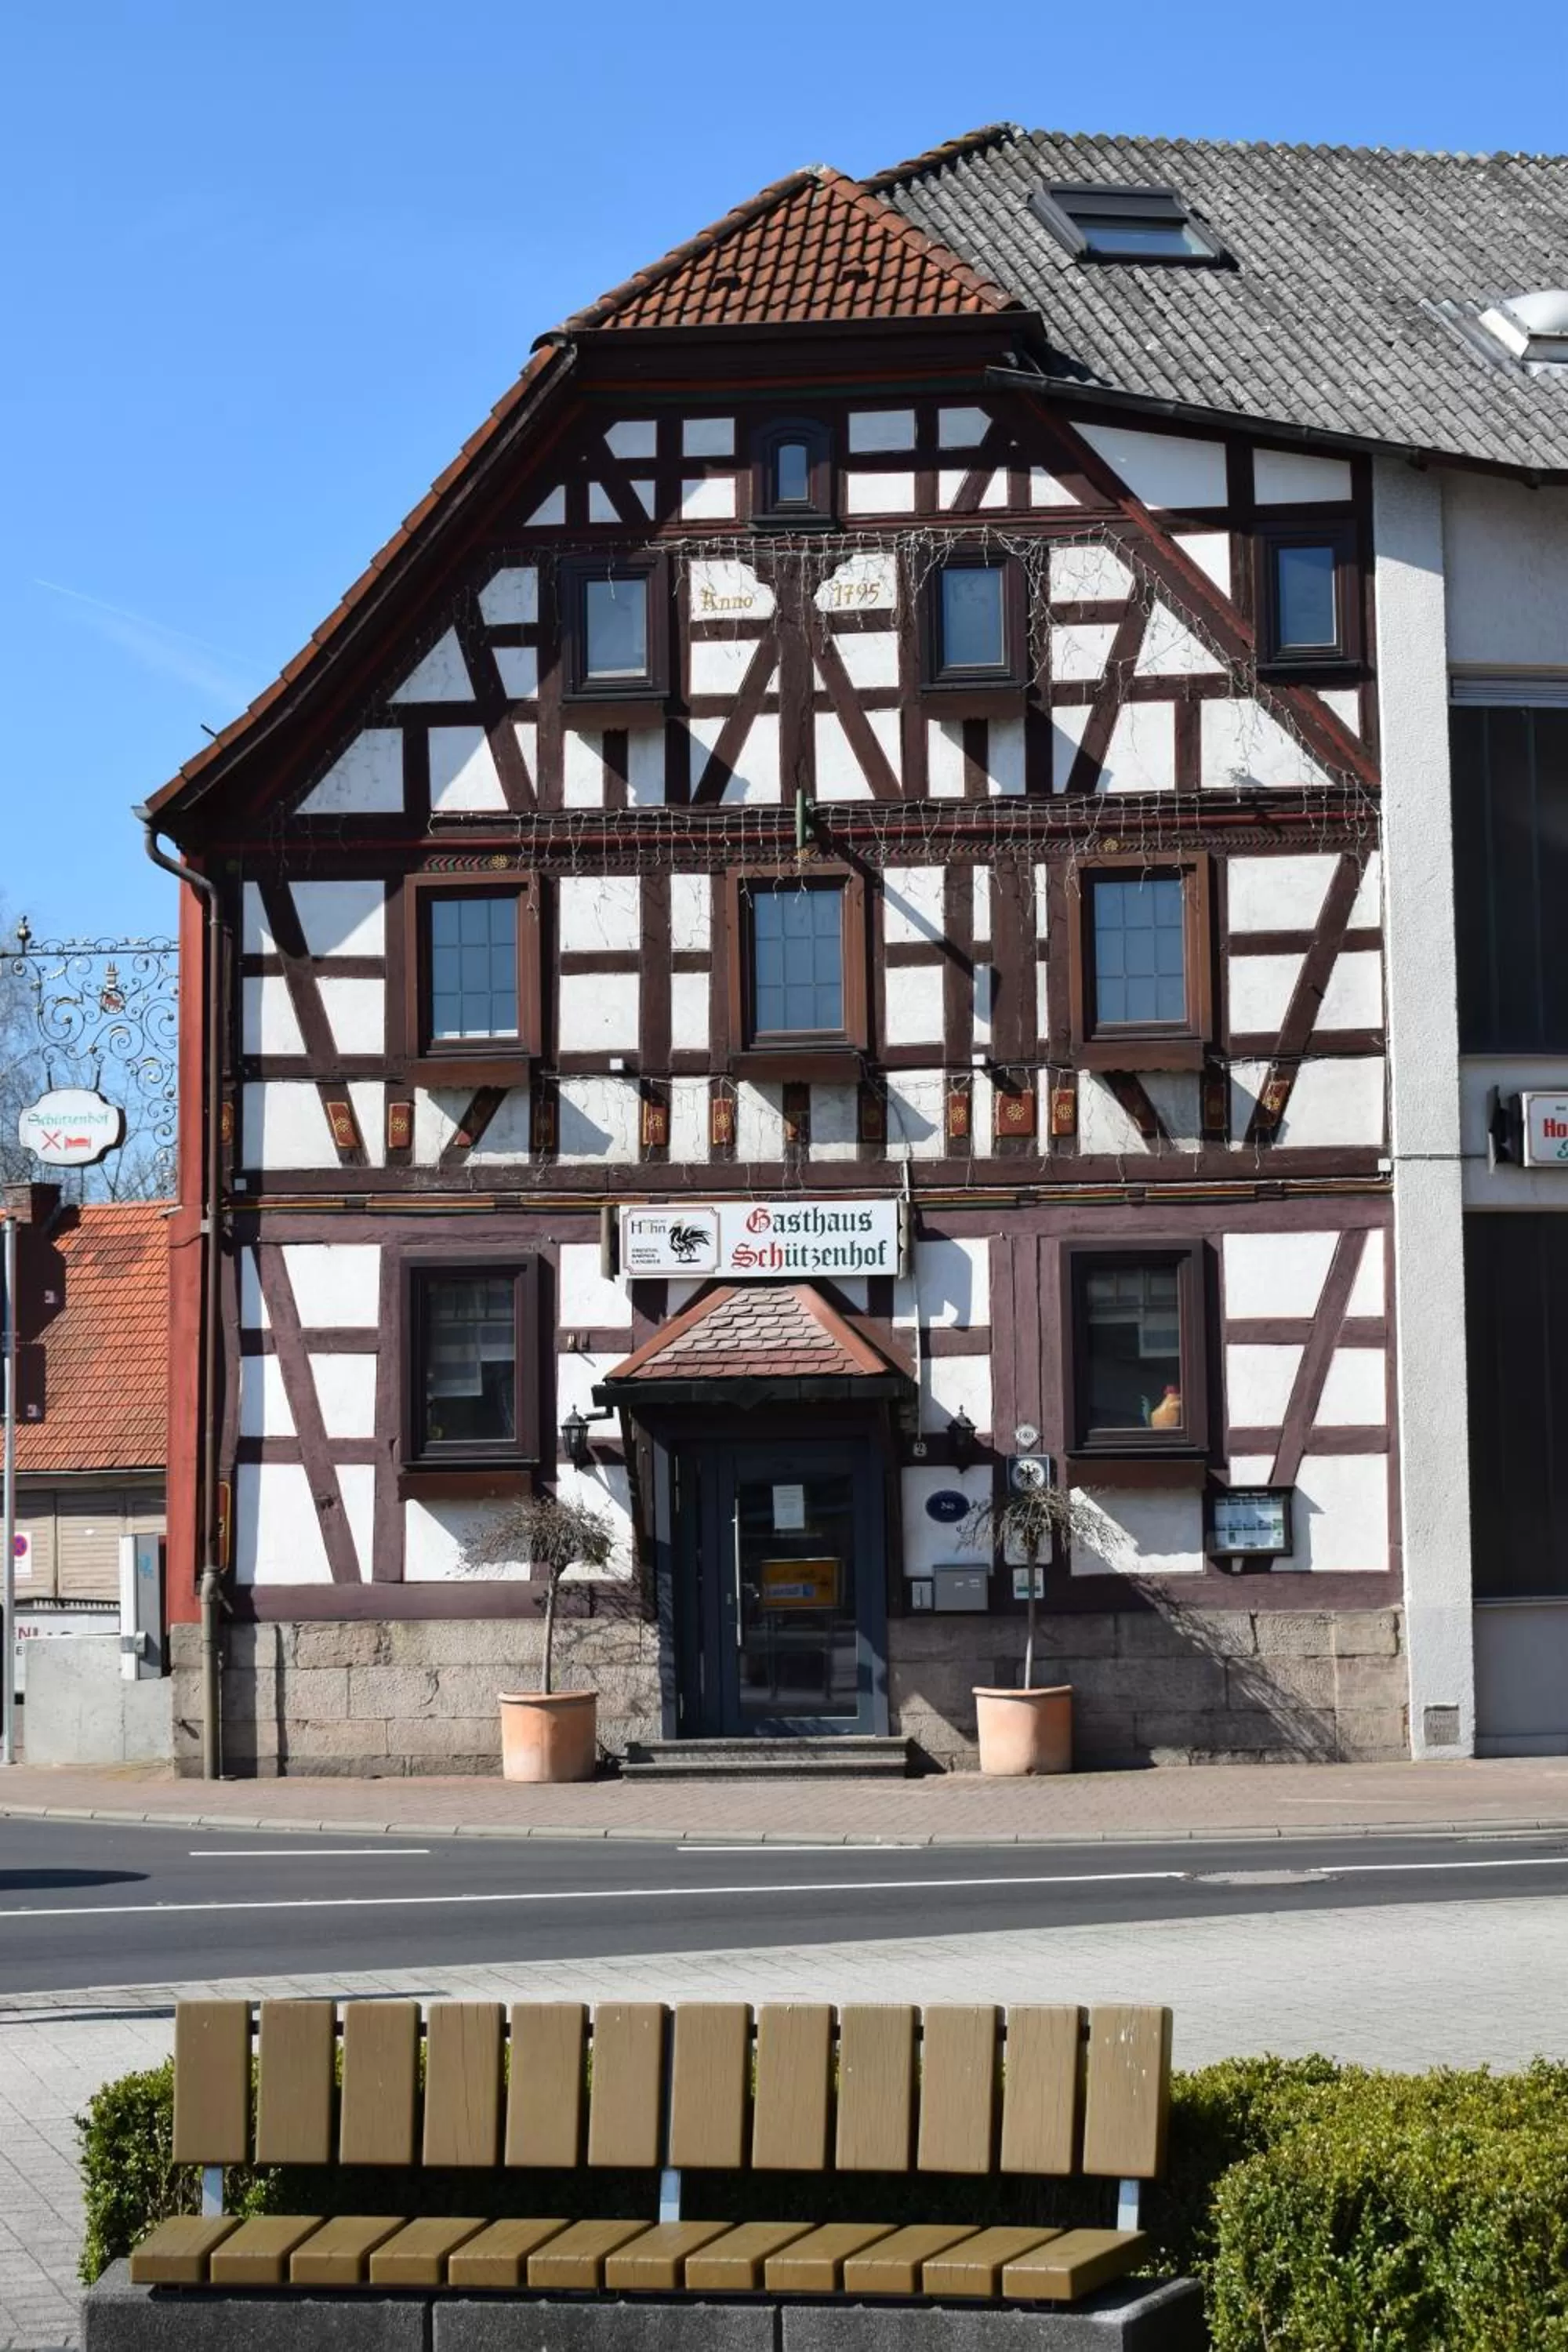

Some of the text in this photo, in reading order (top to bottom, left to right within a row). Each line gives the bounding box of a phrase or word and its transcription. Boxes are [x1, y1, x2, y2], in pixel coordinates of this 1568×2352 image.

[700, 581, 880, 612] Anno 1795
[631, 1219, 666, 1235] Hhn
[745, 1206, 873, 1243] Gasthaus
[731, 1239, 888, 1272] Schützenhof
